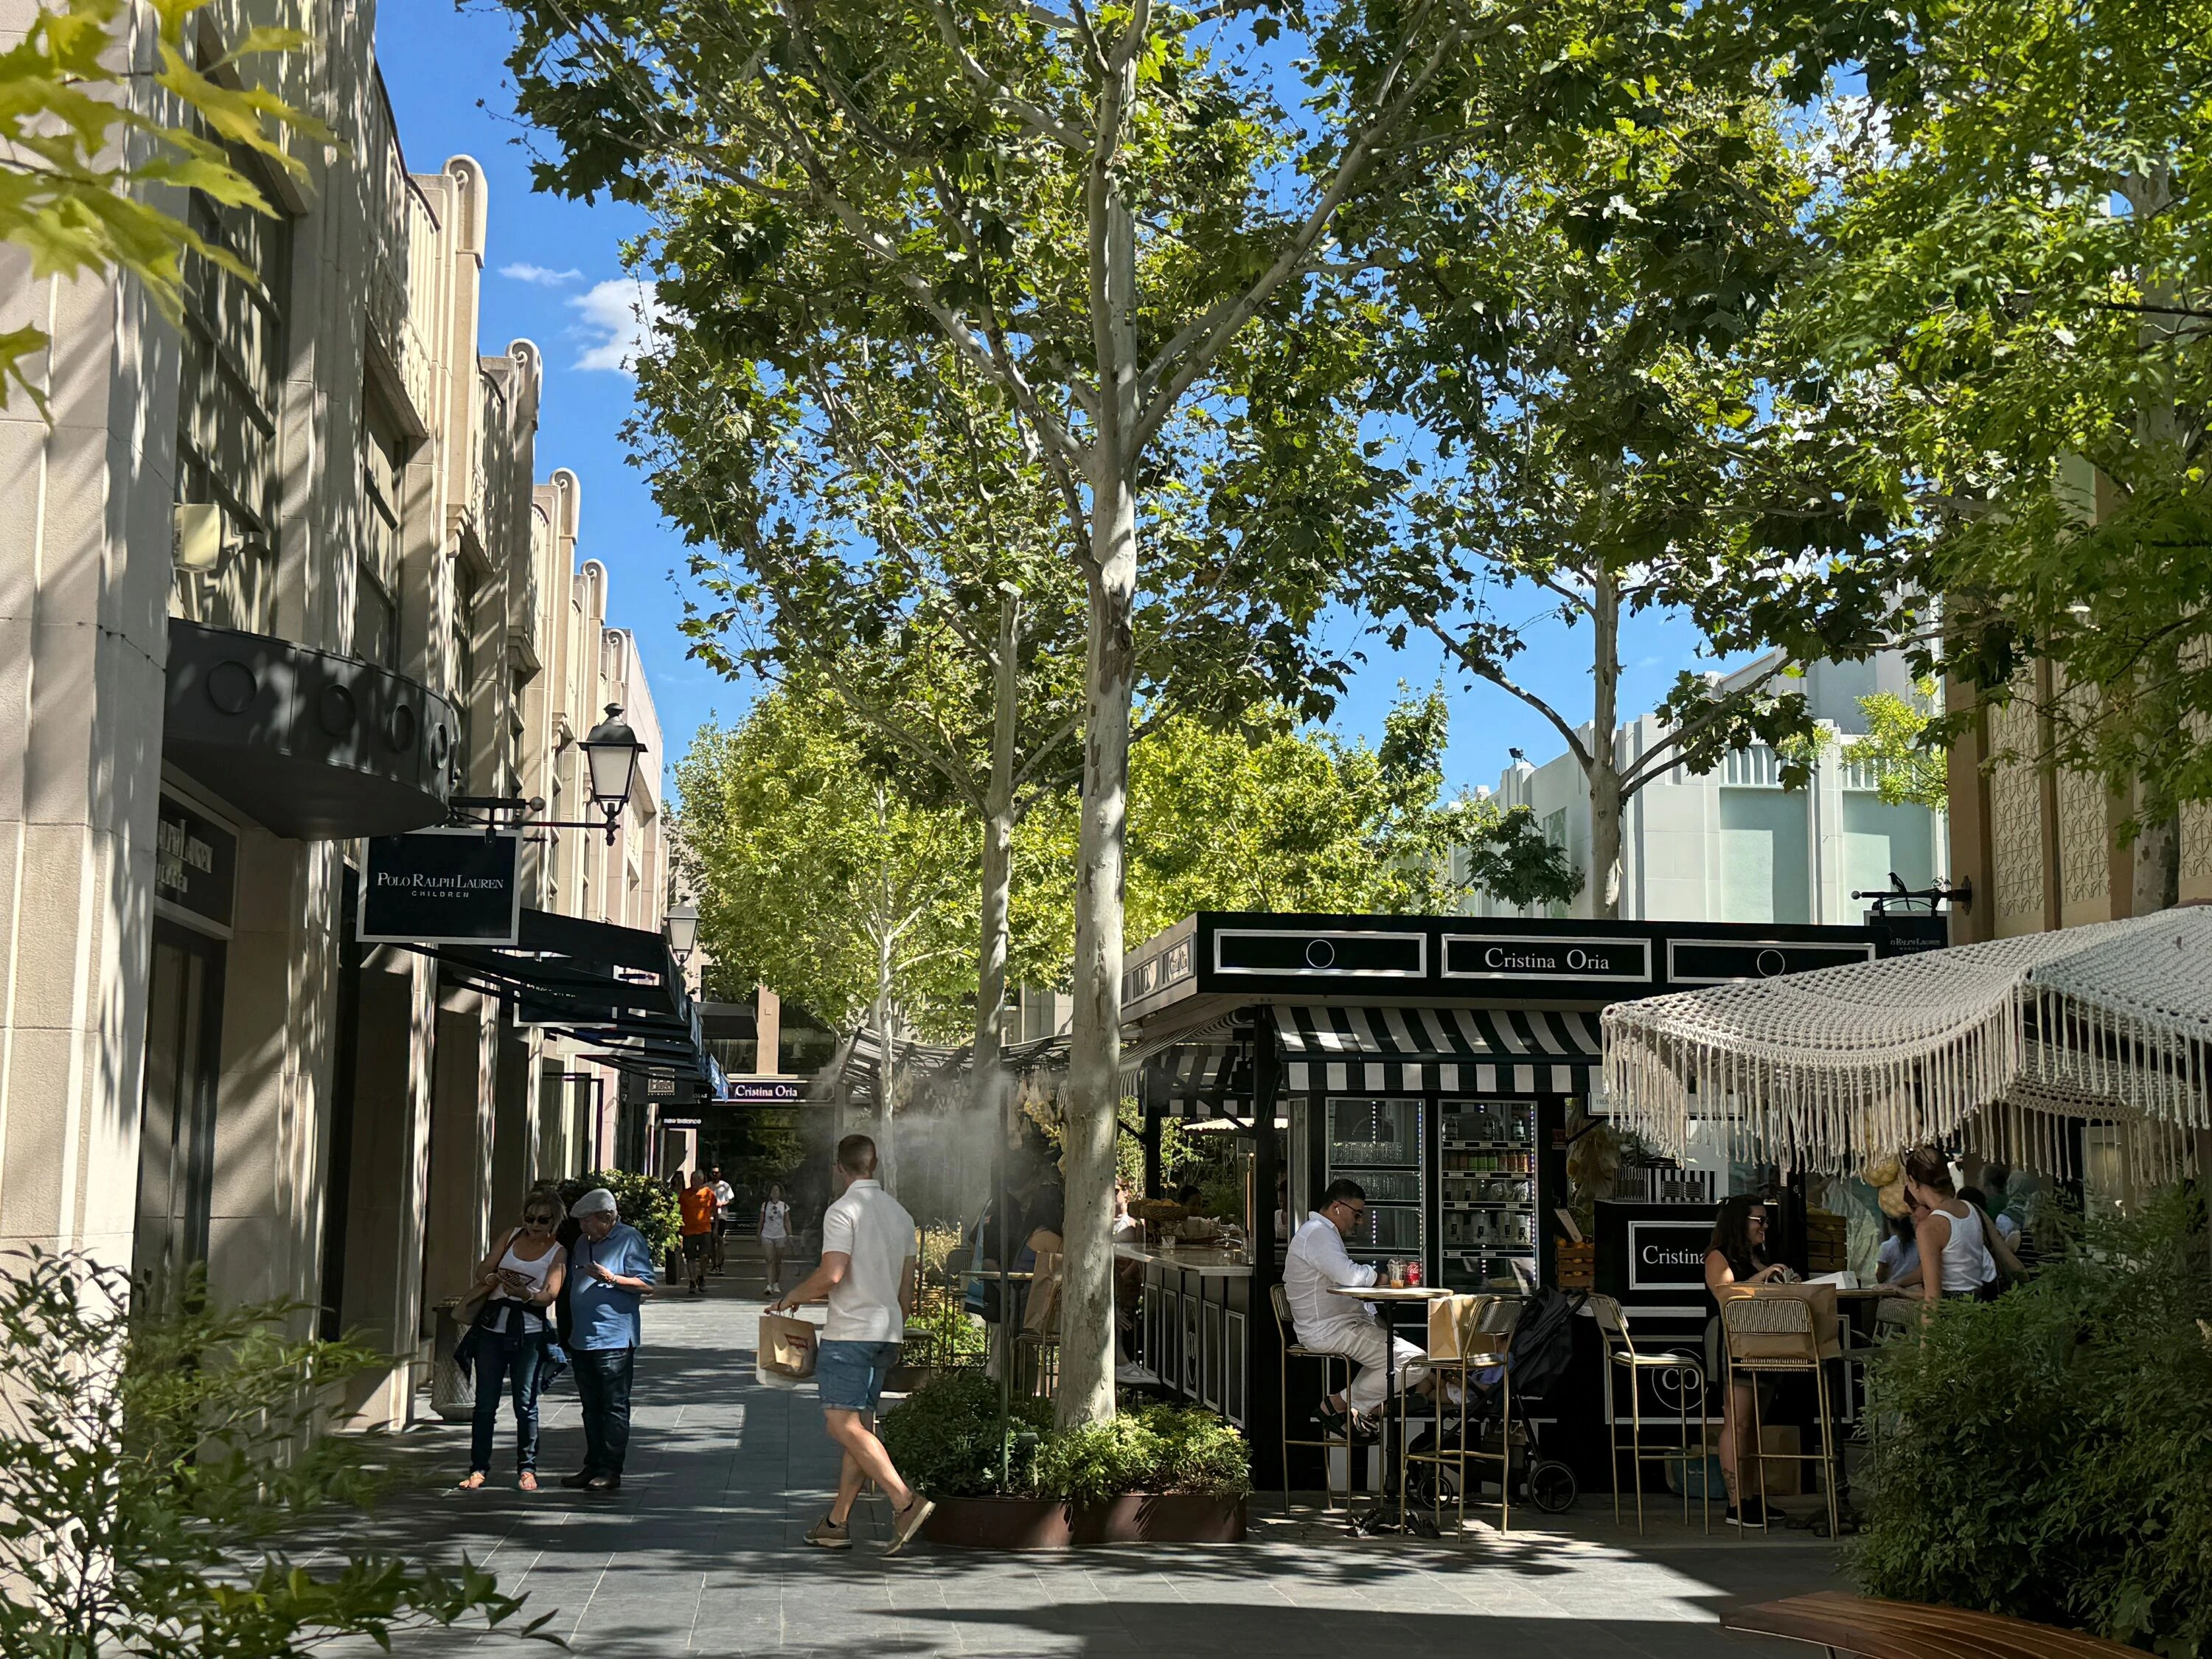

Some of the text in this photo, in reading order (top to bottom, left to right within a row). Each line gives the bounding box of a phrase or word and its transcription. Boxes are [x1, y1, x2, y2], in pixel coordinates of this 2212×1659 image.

[378, 872, 504, 889] POLO RALPH LAUREN
[411, 890, 470, 898] CHILDREN
[1485, 947, 1610, 970] Cristina Oria
[735, 1085, 798, 1097] Cristina Oria
[1642, 1245, 1705, 1265] Cristina
